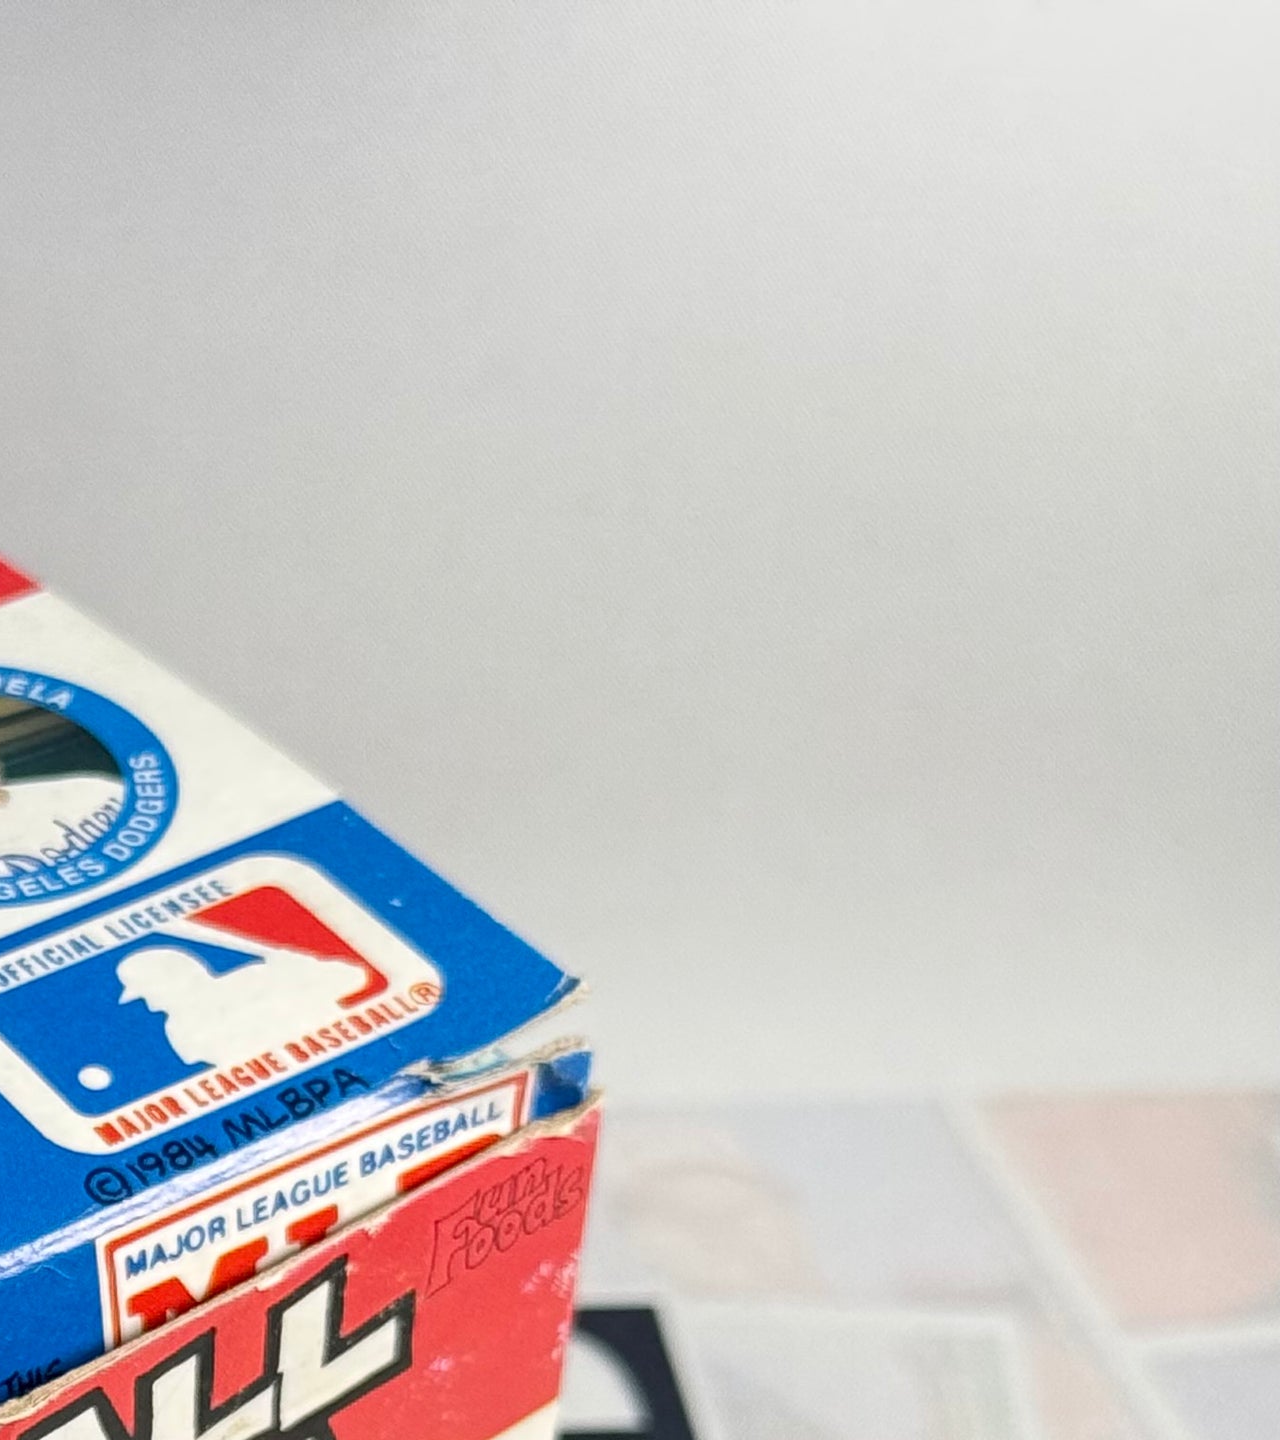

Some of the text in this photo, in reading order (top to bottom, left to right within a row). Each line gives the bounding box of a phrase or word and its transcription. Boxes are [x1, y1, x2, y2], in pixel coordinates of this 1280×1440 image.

[103, 750, 167, 862] DODGERS
[103, 876, 234, 940] LICENSEE
[92, 1089, 183, 1149] MAJOR
[183, 1050, 281, 1114] LEAGUE
[221, 1067, 371, 1142] MLBPA
[123, 1214, 227, 1281] MAJOR
[234, 1160, 351, 1233] LEAGUE
[358, 1097, 505, 1179] BASEBALL
